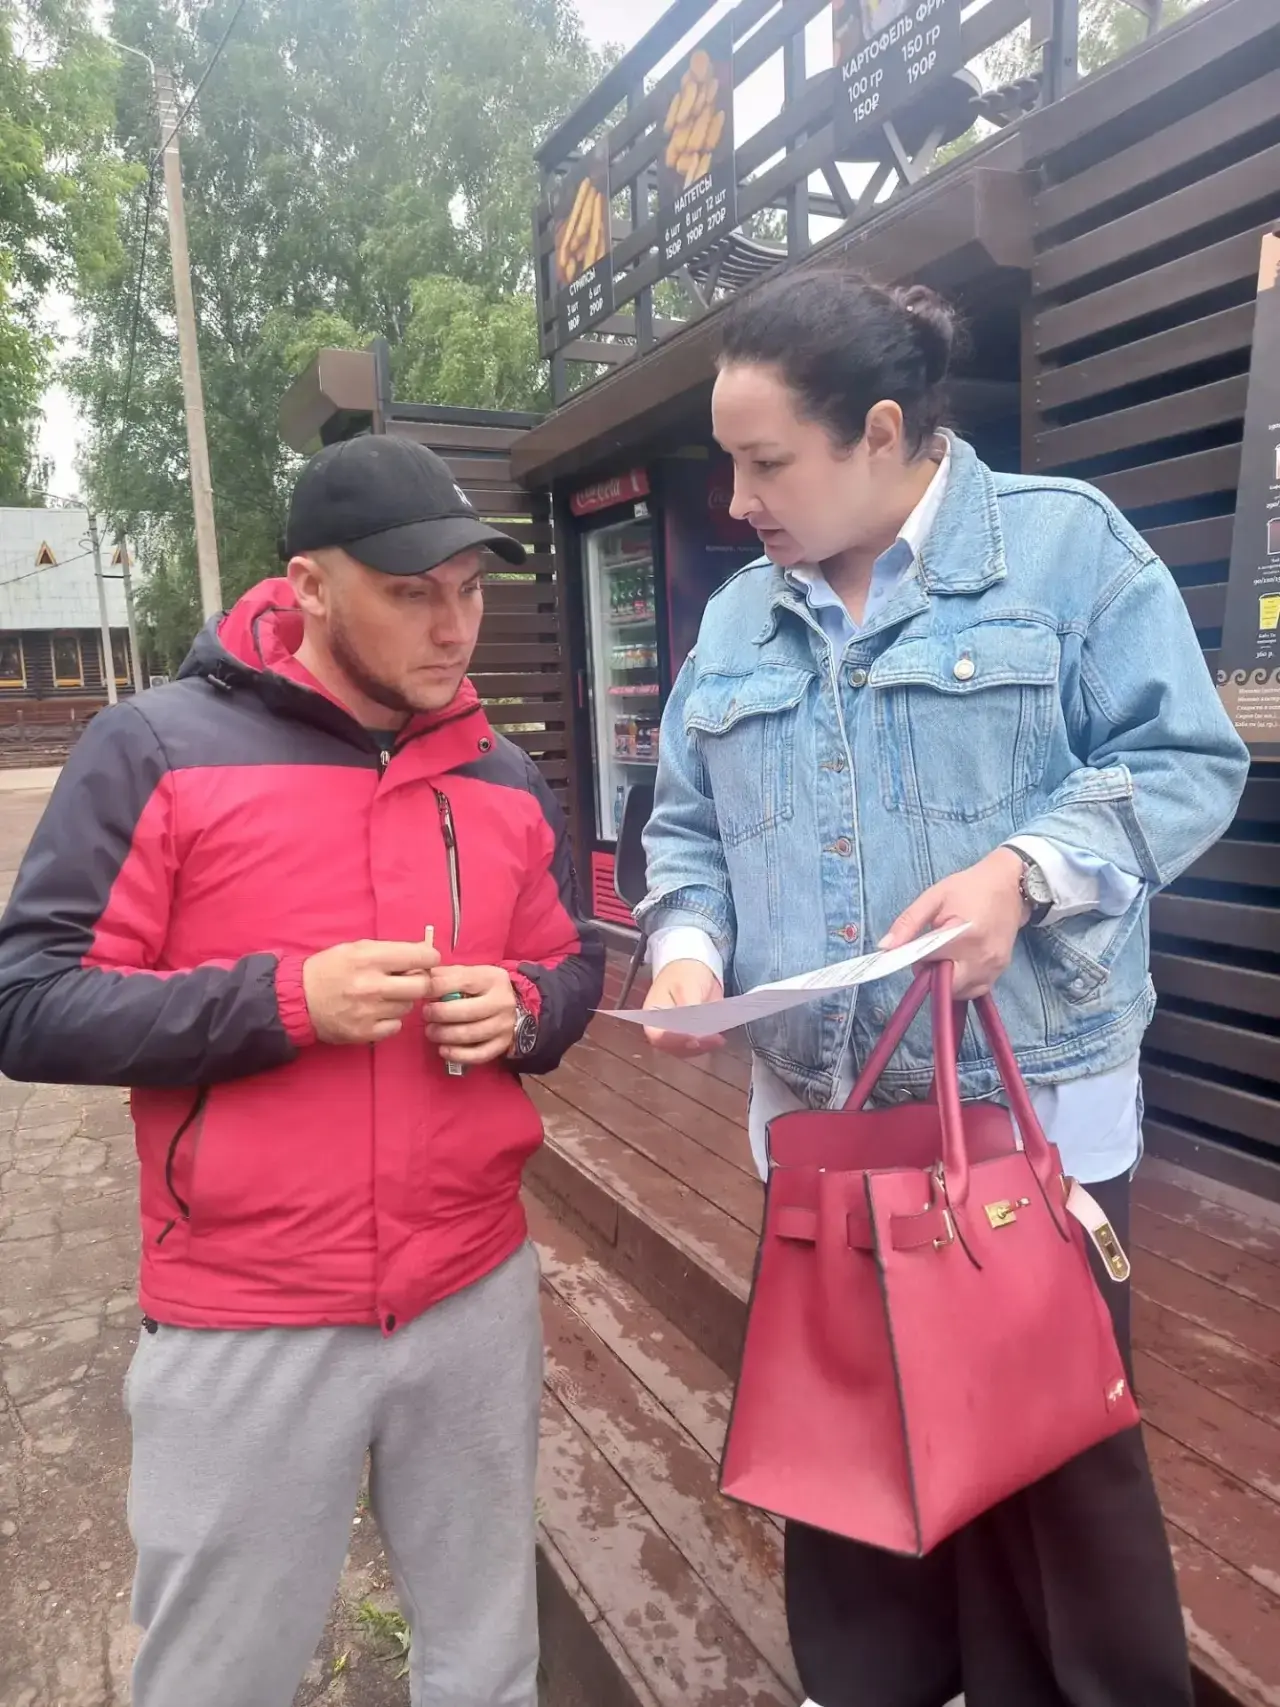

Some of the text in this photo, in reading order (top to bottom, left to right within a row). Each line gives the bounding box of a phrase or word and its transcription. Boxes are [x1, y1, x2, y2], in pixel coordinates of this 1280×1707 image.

[842, 15, 914, 82] КАРТОФЕЛЬ
[847, 77, 868, 103] 100
[901, 34, 923, 62] 150
[674, 174, 713, 215] НАГГЕТСЫ
[705, 195, 714, 212] 12
